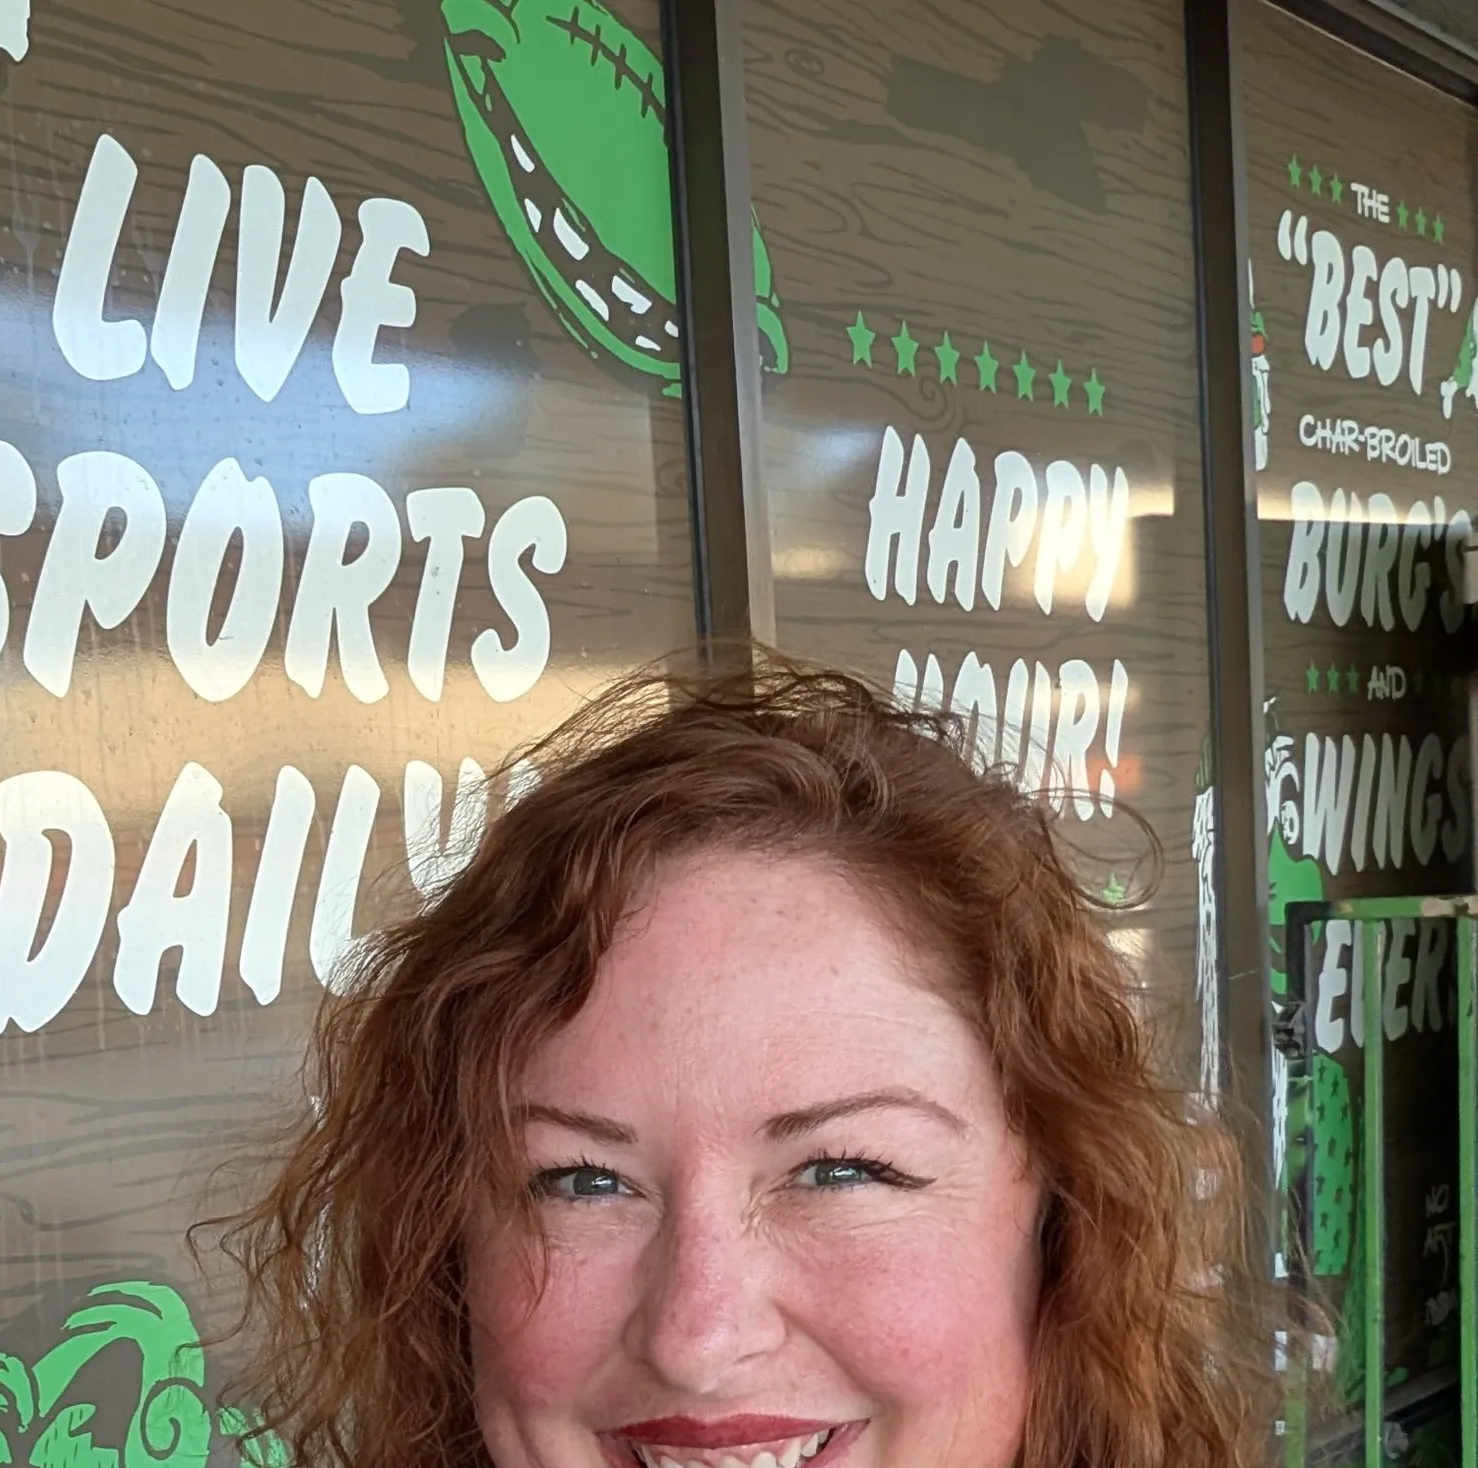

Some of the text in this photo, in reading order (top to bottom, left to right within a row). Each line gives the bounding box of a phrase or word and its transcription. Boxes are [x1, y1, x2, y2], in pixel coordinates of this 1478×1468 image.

[52, 134, 430, 414] LIVE
[1351, 182, 1390, 223] THE
[1299, 414, 1452, 475] CHAR-BROILED
[864, 426, 1129, 622] HAPPY
[1284, 481, 1472, 634] BURG'S
[1367, 664, 1407, 700] AND
[1303, 732, 1472, 876] WINGS
